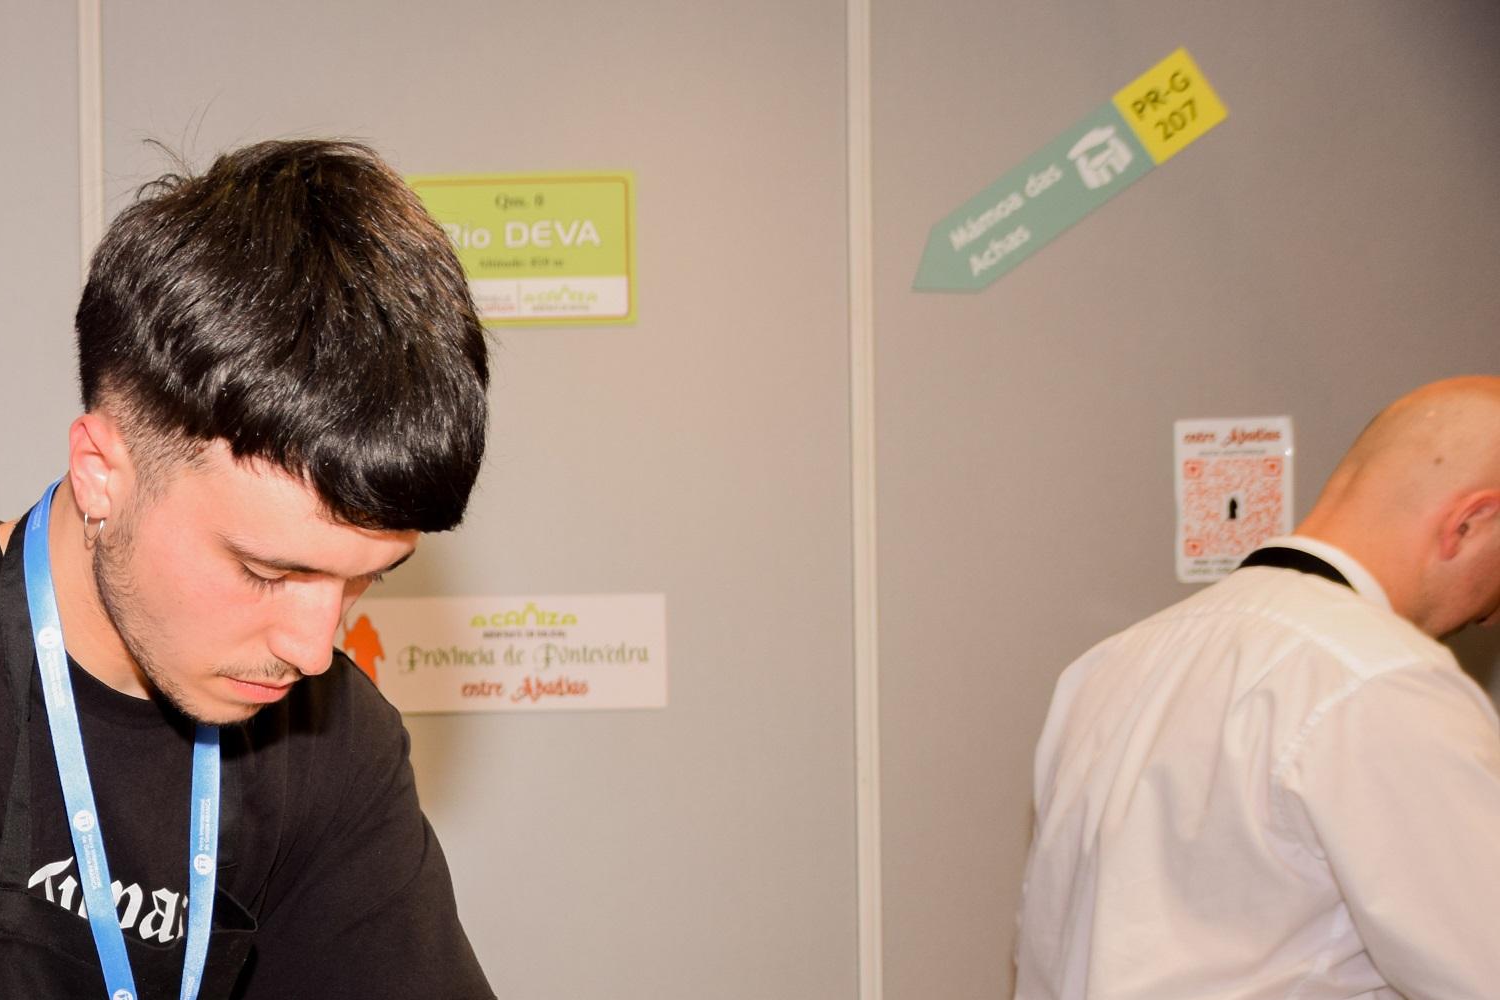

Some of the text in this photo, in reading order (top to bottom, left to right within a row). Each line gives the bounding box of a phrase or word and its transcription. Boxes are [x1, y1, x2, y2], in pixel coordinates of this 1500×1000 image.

[1130, 69, 1192, 122] PR-G
[1155, 97, 1199, 142] 207
[504, 219, 601, 249] DEVA
[503, 644, 524, 666] de
[532, 643, 649, 670] Pontevedra
[461, 678, 504, 699] entre
